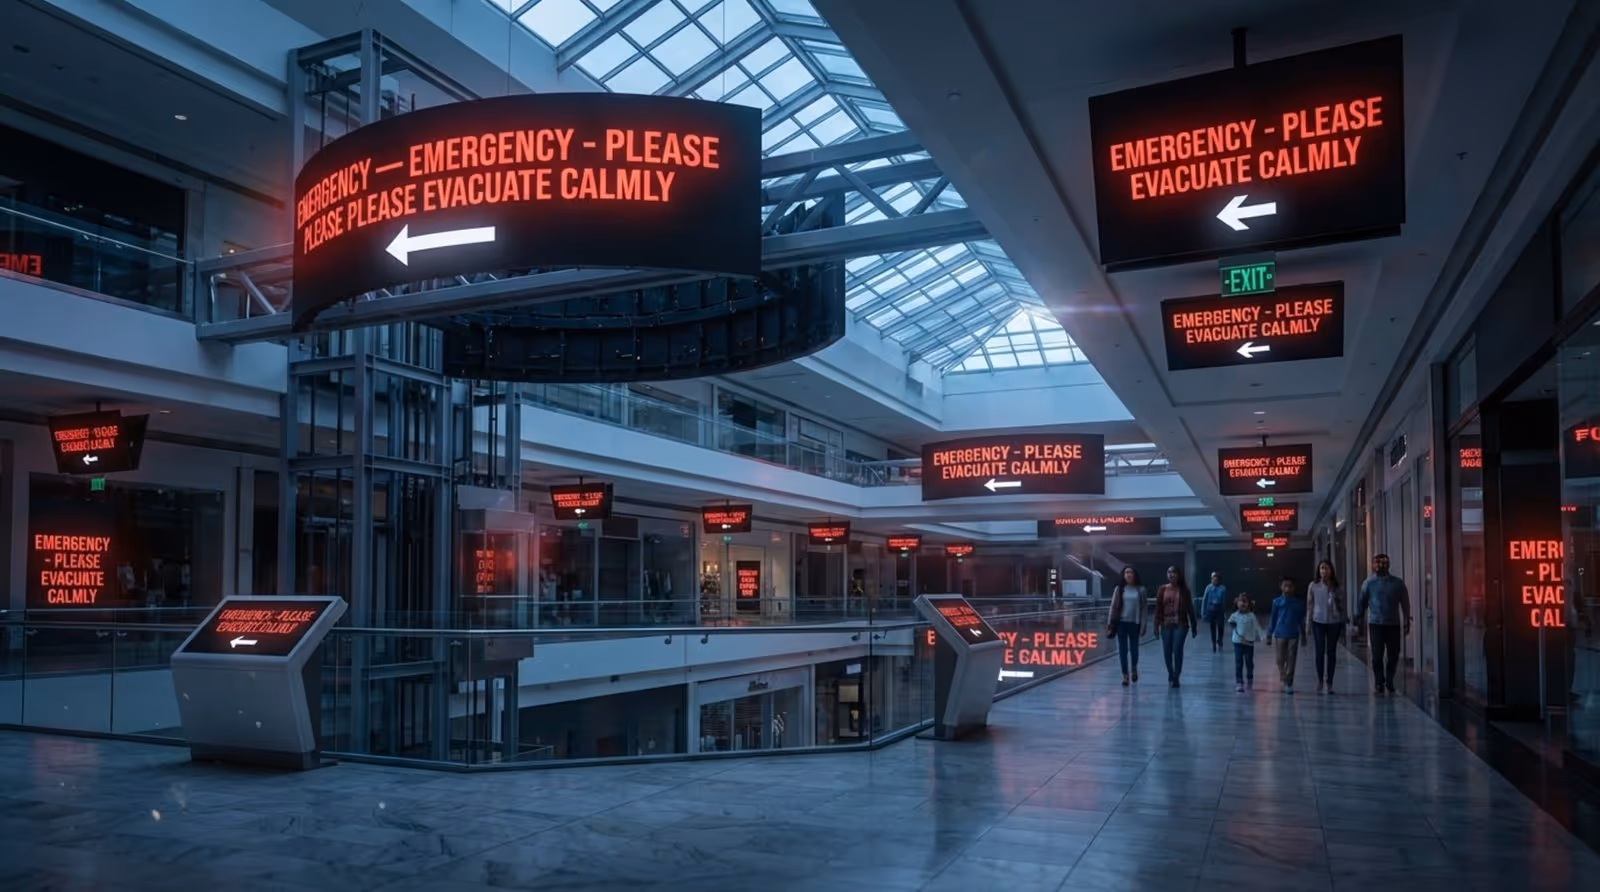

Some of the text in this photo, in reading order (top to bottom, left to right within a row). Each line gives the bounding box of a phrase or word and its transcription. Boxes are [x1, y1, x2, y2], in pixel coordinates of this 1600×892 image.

[1110, 119, 1257, 171] EMERGENCY
[1283, 96, 1383, 142] PLEASE
[409, 128, 574, 177] EMERGENCY
[606, 128, 720, 169] PLEASE
[1131, 136, 1362, 200] EVACUATE CALMLY
[347, 184, 417, 232] PLEASE
[423, 168, 552, 212] EVACUATE
[561, 167, 676, 202] CALMLY
[1231, 266, 1267, 293] EXIT
[1275, 298, 1333, 319] PLEASE
[1186, 317, 1320, 344] EVACUATE CALMLY
[1024, 445, 1082, 460] PLEASE
[1011, 461, 1071, 475] CALMLY
[1510, 540, 1564, 560] EMER
[54, 553, 101, 569] PLEASE
[47, 588, 98, 604] CALMLY
[1034, 631, 1098, 649] PLEASE
[1018, 649, 1085, 666] CALMLY
